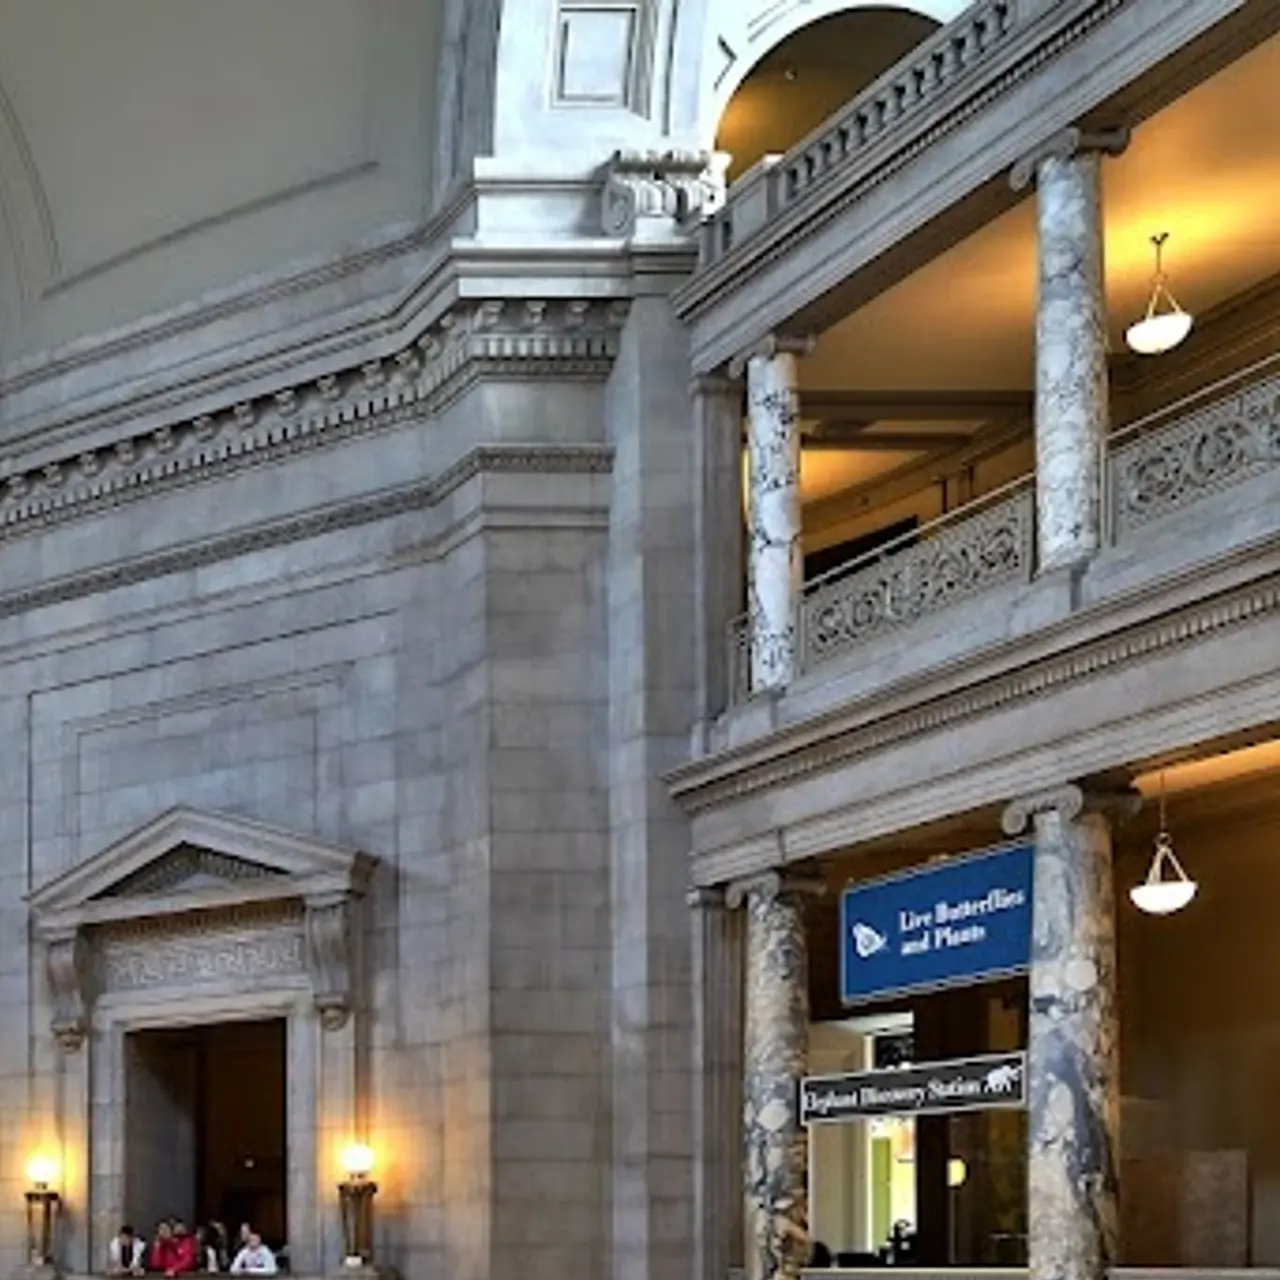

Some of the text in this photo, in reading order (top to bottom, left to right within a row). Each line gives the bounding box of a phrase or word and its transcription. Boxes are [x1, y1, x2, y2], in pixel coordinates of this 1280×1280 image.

[900, 888, 1025, 932] Live Butterflies
[901, 925, 986, 955] and Plants
[927, 1076, 981, 1098] Station
